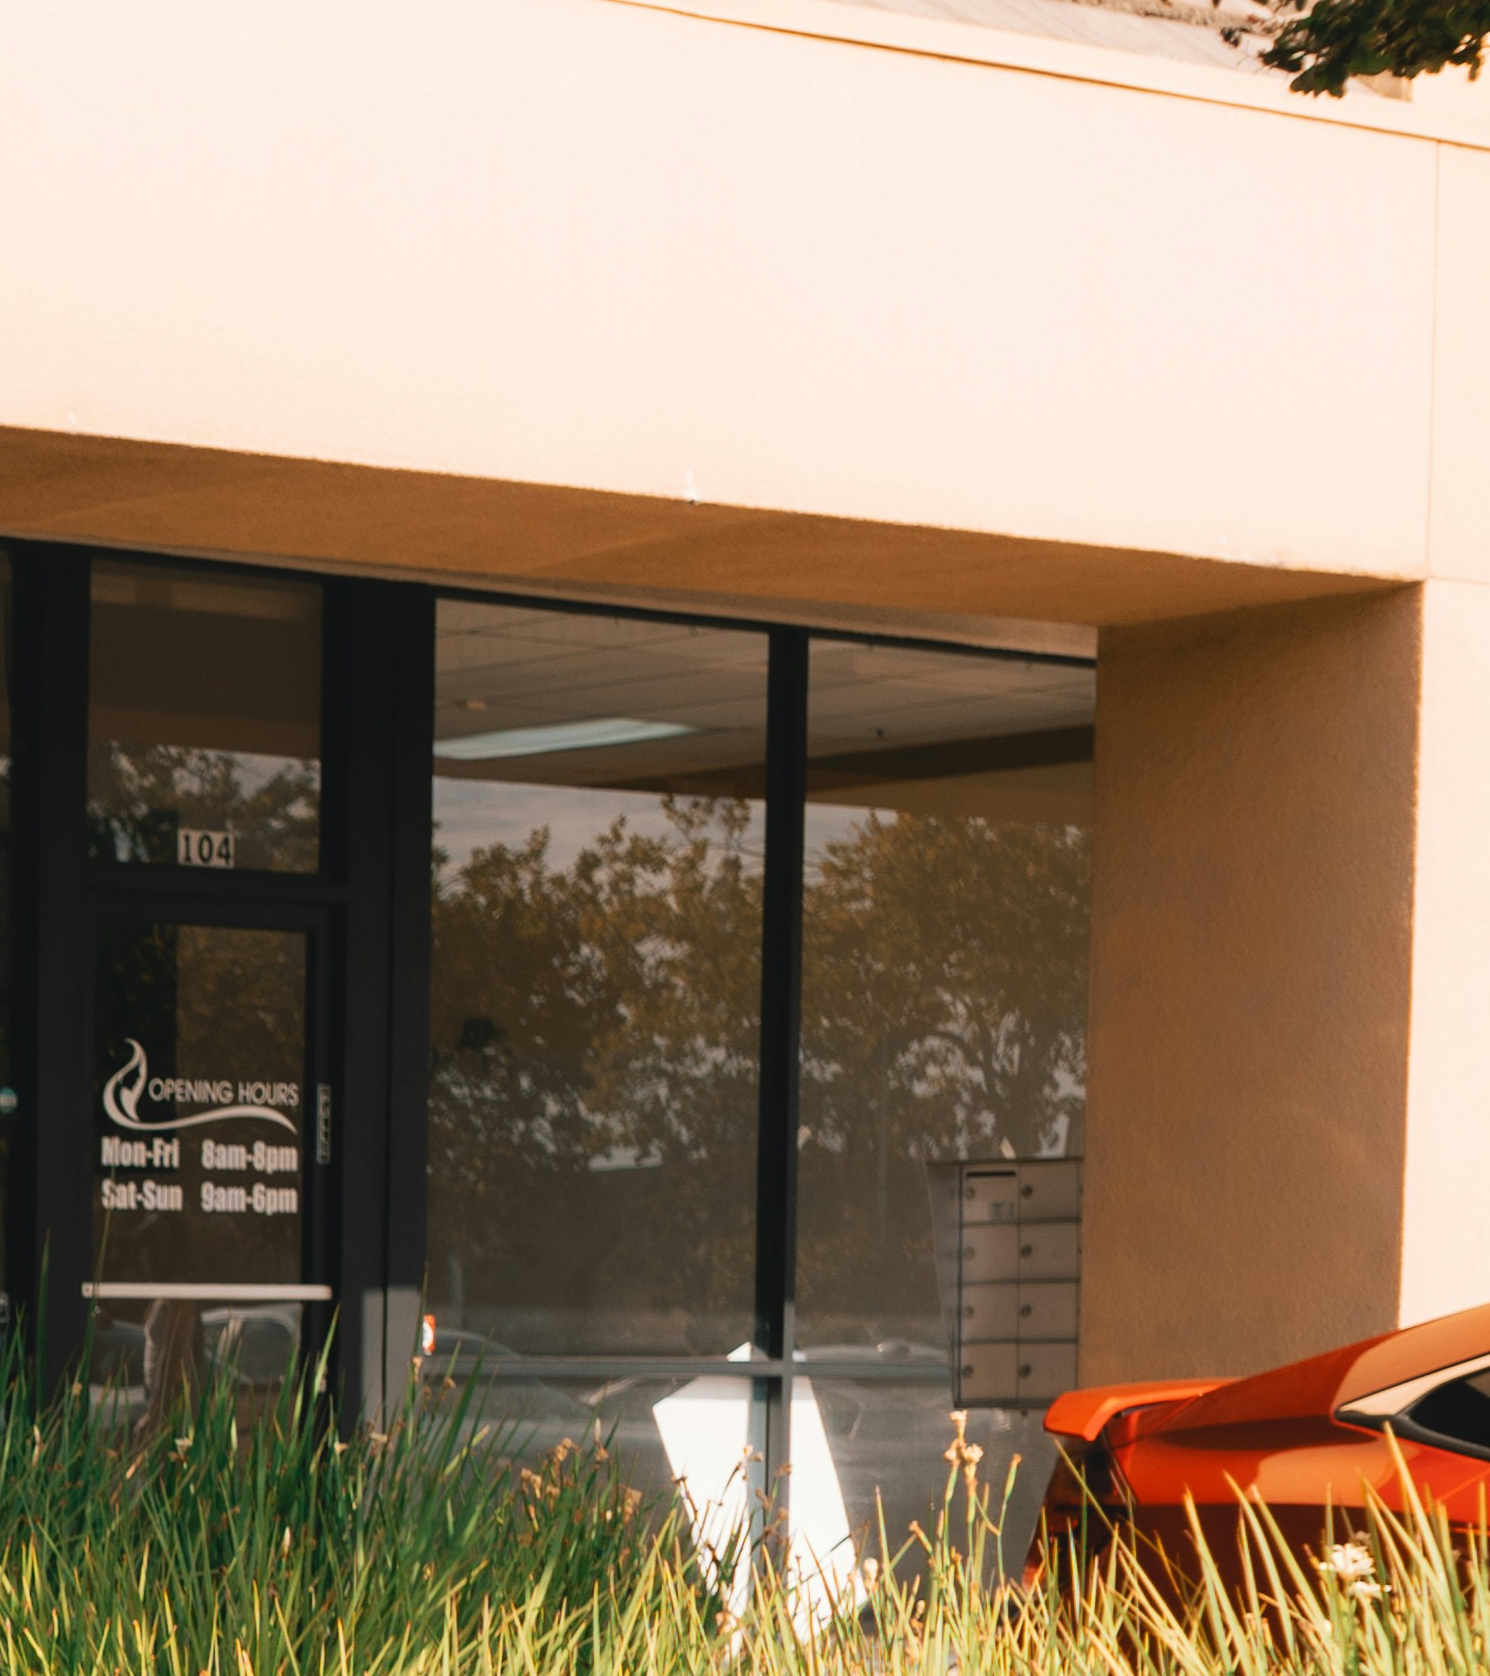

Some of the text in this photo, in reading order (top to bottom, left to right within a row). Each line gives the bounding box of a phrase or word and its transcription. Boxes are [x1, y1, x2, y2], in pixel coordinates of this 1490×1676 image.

[182, 832, 231, 866] 104
[148, 1077, 300, 1107] OPENING HOURS
[101, 1136, 299, 1174] Mon-Fri 8am-8pm
[101, 1179, 298, 1216] Sat-Sun 9am-6pm
